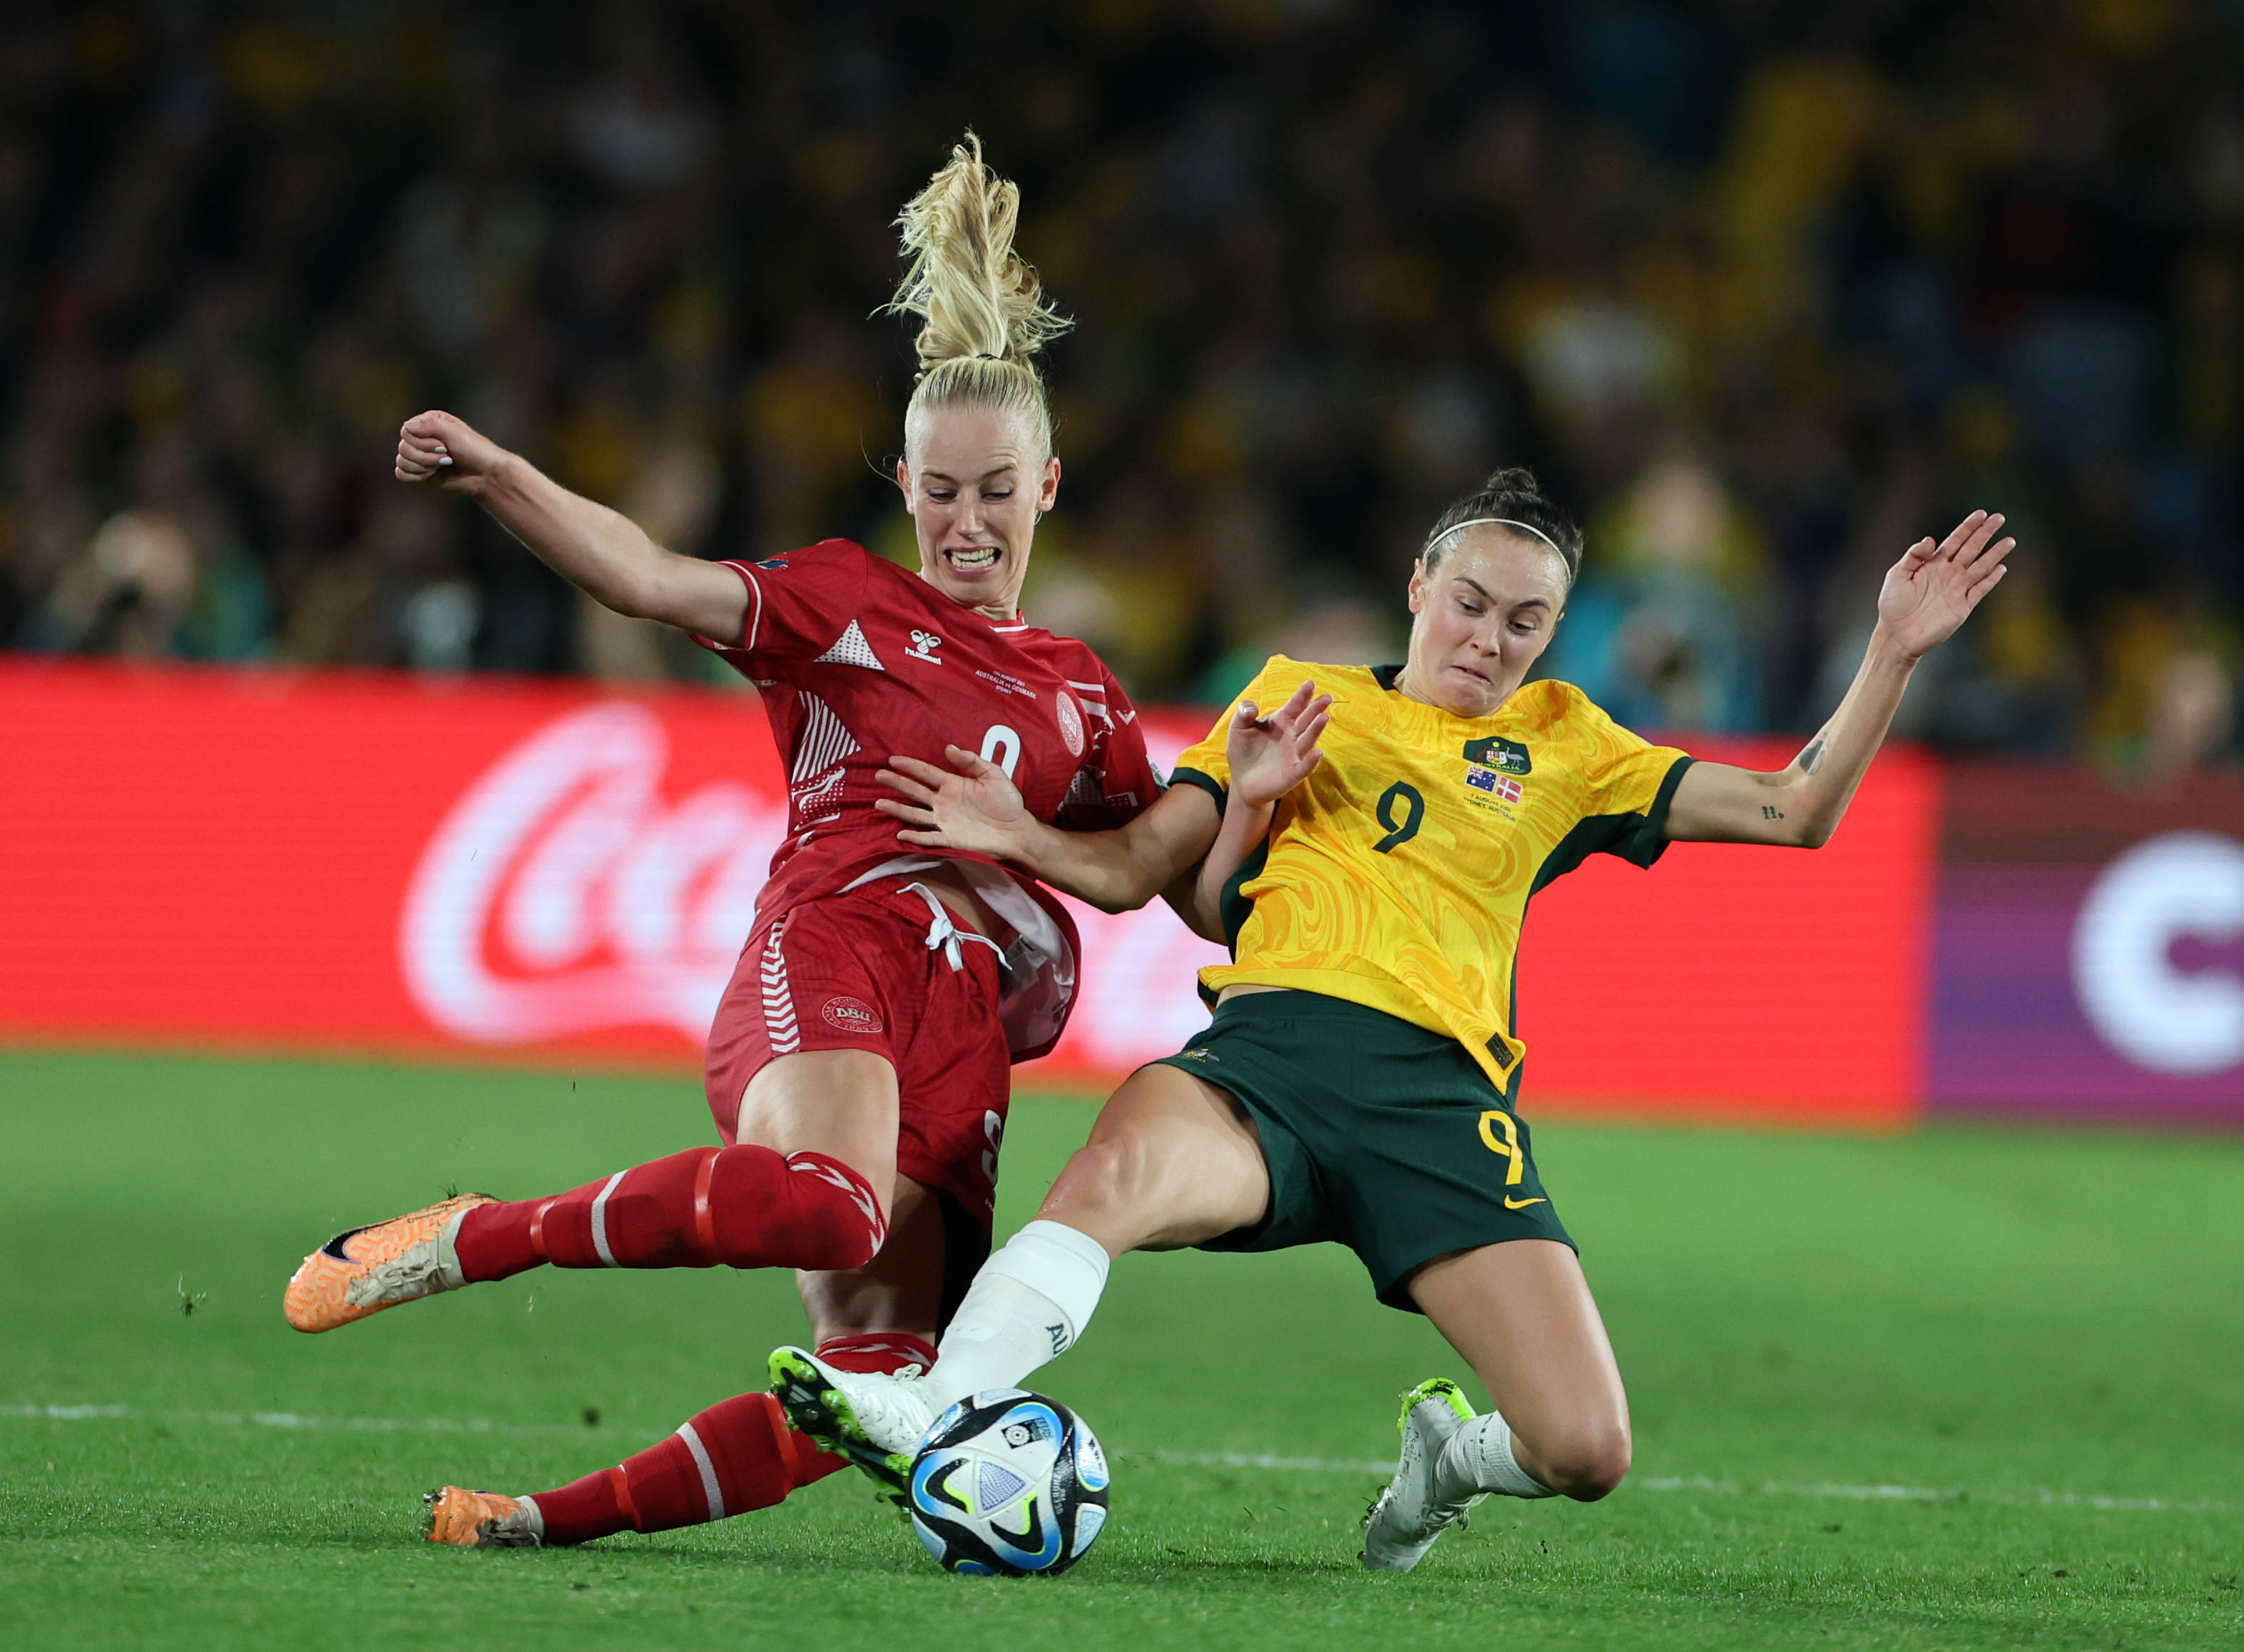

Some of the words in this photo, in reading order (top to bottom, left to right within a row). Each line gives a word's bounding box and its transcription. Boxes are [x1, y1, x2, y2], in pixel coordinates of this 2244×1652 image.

[904, 647, 942, 665] hummel
[974, 669, 1004, 685] AUSTRALIA
[1011, 684, 1036, 699] DENMARK
[1372, 780, 1425, 855] 9
[835, 1007, 870, 1022] DBU
[1478, 1110, 1524, 1186] 9
[1045, 1323, 1068, 1355] AU
